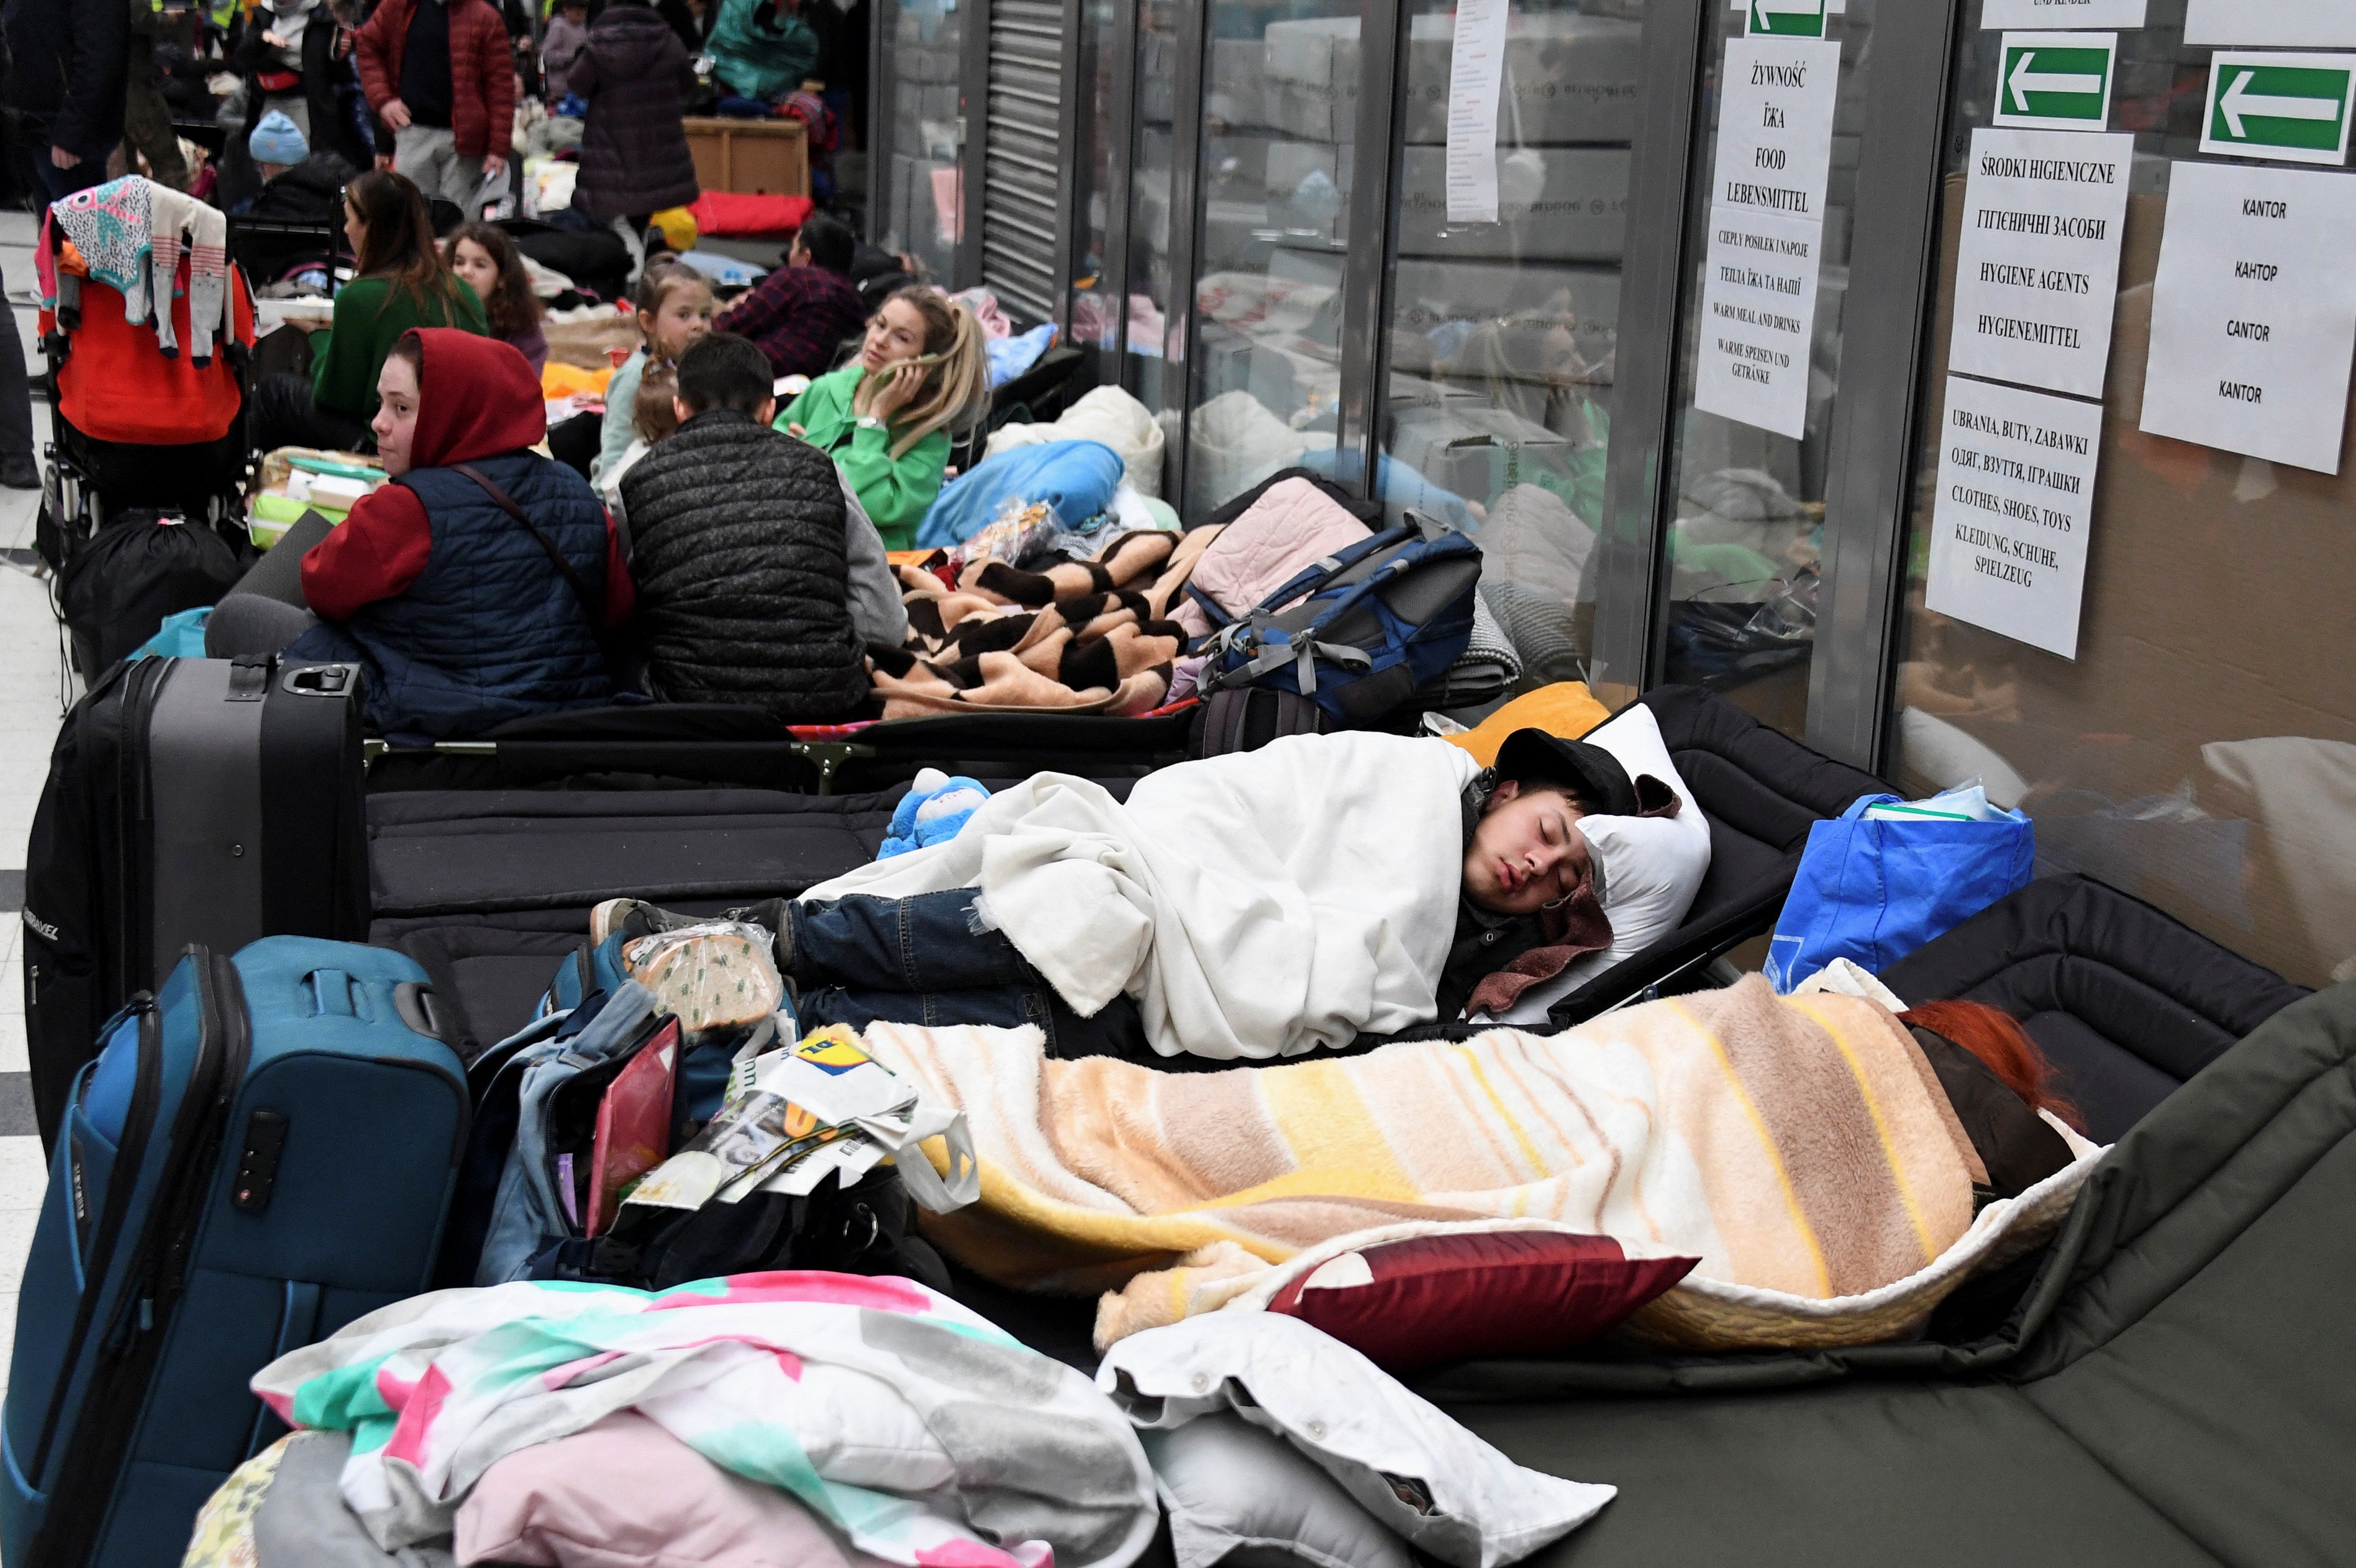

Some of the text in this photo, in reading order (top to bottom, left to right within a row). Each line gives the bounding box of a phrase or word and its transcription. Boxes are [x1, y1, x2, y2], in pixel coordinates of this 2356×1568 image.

[1752, 60, 1806, 88] ŻYWNOŚĆ
[1763, 102, 1784, 128] ЇЖА
[1755, 148, 1785, 170] FOOD
[1981, 151, 2115, 184] ŚRODKI HIGIENICZNE
[1727, 182, 1808, 212] LEBENSMITTEL
[2243, 199, 2286, 219] KANTOR
[1977, 210, 2106, 240] ГІГІЄНИЧНІ ЗАСОБИ
[1780, 240, 1808, 257] NAPOJE
[1720, 267, 1745, 284] ТЕПЛА
[1747, 268, 1762, 288] ЇЖА
[1980, 263, 2089, 294] HYGIENE AGENTS
[1714, 302, 1800, 333] WARM MEAL AND DRINKS
[1978, 315, 2080, 348] HYGIENEMITTEL
[2227, 320, 2269, 342] CANTOR
[1719, 339, 1789, 368] WARME SPEISEN UND
[1732, 363, 1770, 384] GETRÄNKE
[2219, 381, 2262, 404] KANTOR
[1952, 410, 2088, 455] UBRANIA, BUTY, ZABAWKI
[1952, 448, 2080, 494] ОДЯГ, ВЗУТТЯ, ІГРАШКИ
[1952, 486, 2071, 532] CLOTHES, SHOES, TOYS
[1955, 523, 2058, 572] KLEIDUNG, SCHUHE,
[1975, 556, 2032, 587] SPIELZEUG
